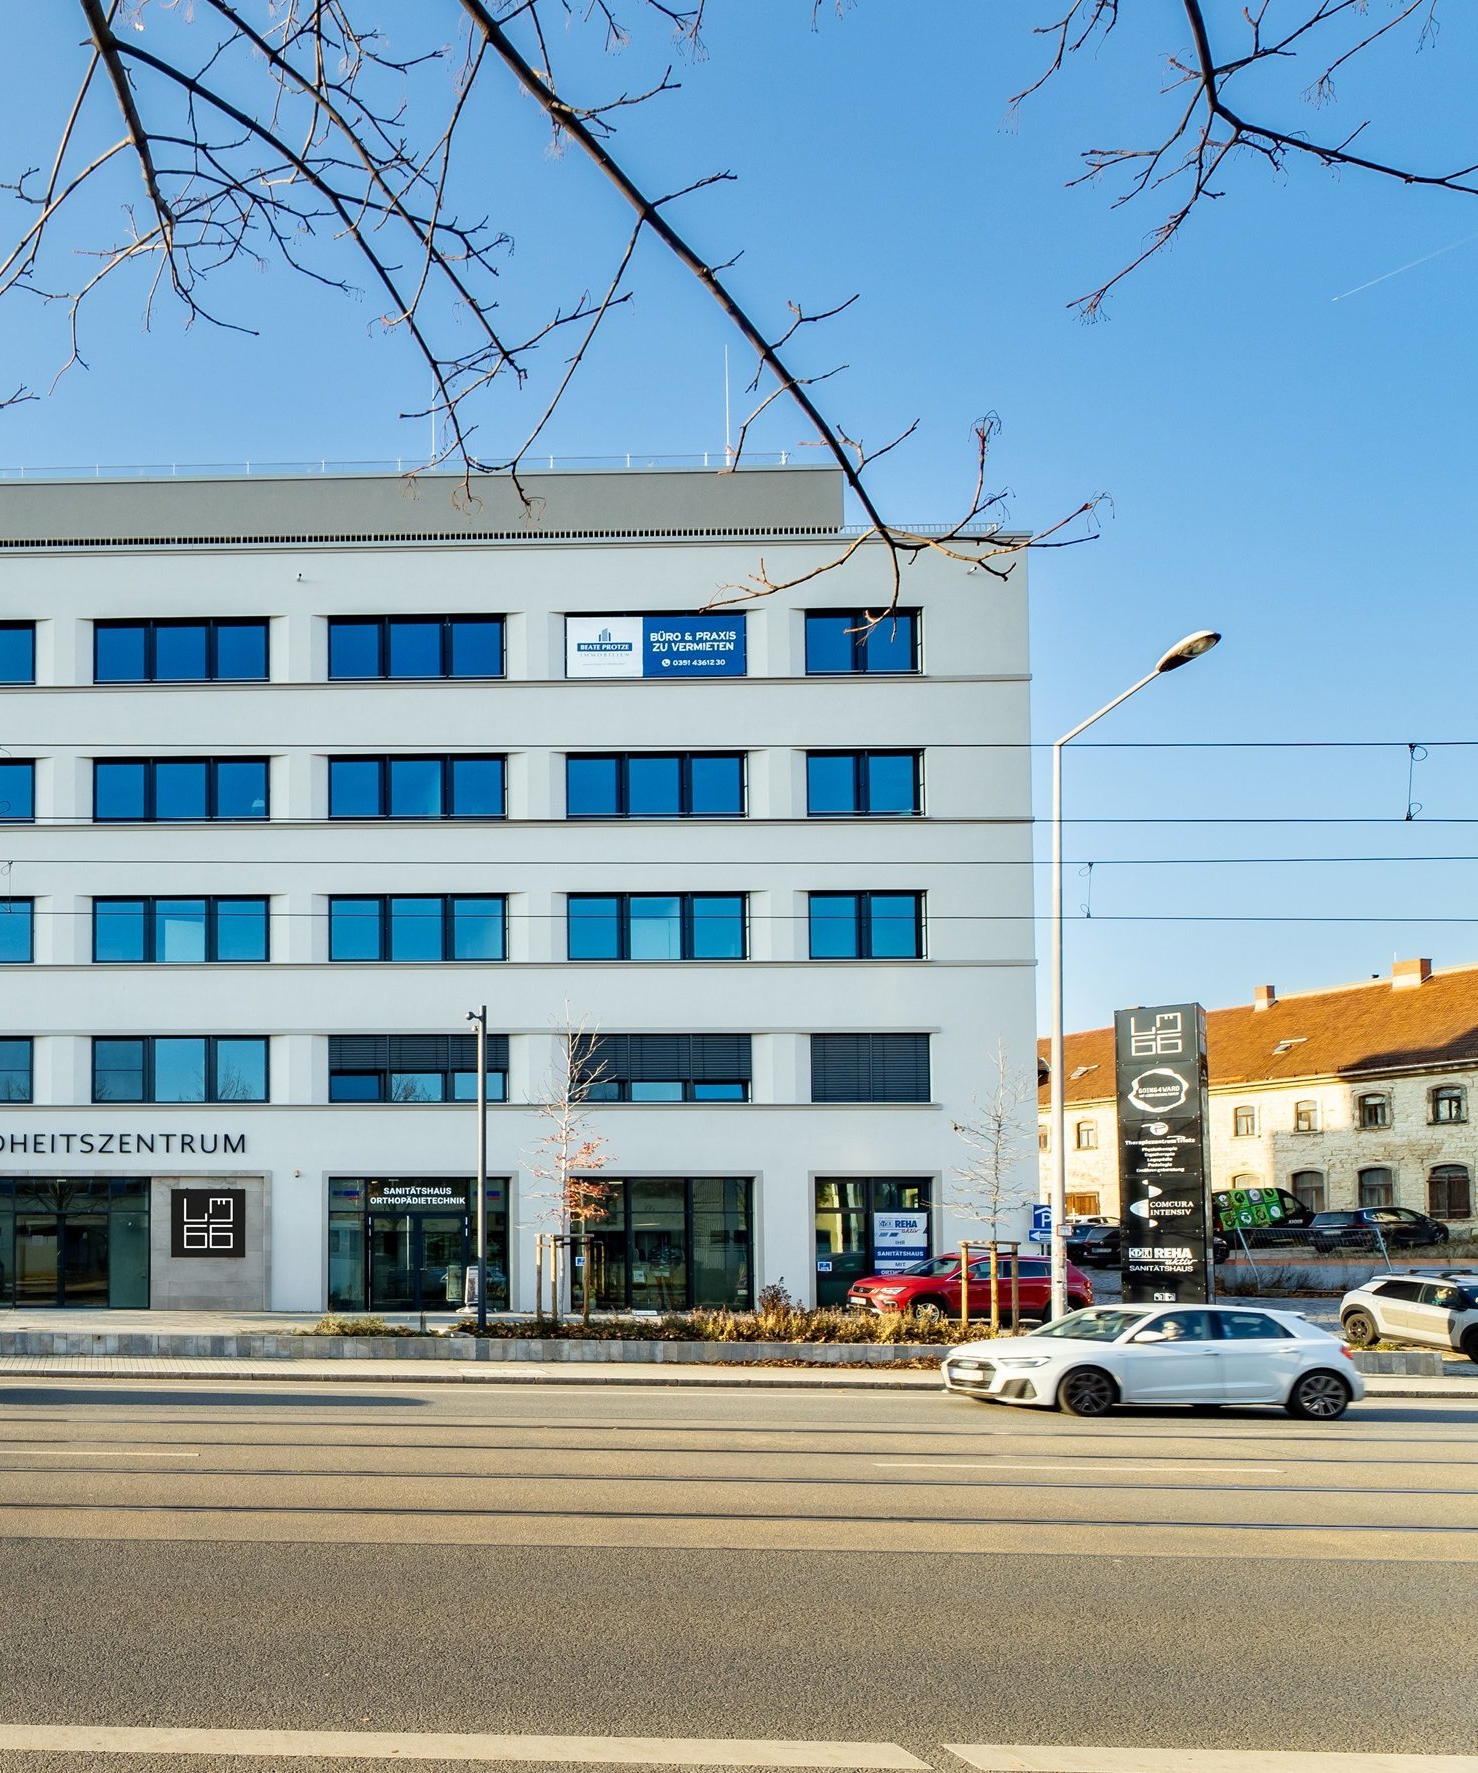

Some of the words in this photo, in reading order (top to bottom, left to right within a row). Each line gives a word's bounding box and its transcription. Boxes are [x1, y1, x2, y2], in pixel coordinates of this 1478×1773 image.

[650, 631, 681, 641] BÜRO
[696, 631, 736, 640] PRAXIS
[652, 643, 668, 651] ZU
[671, 642, 734, 651] VERMIETEN
[383, 1186, 452, 1195] SANITÄTSHAUS
[370, 1196, 466, 1204] ORTHOPÄDIETECHNIK
[895, 1220, 918, 1228] REHA
[1042, 1213, 1051, 1227] P
[1154, 1248, 1193, 1258] REHA
[1165, 1256, 1198, 1265] aktiv
